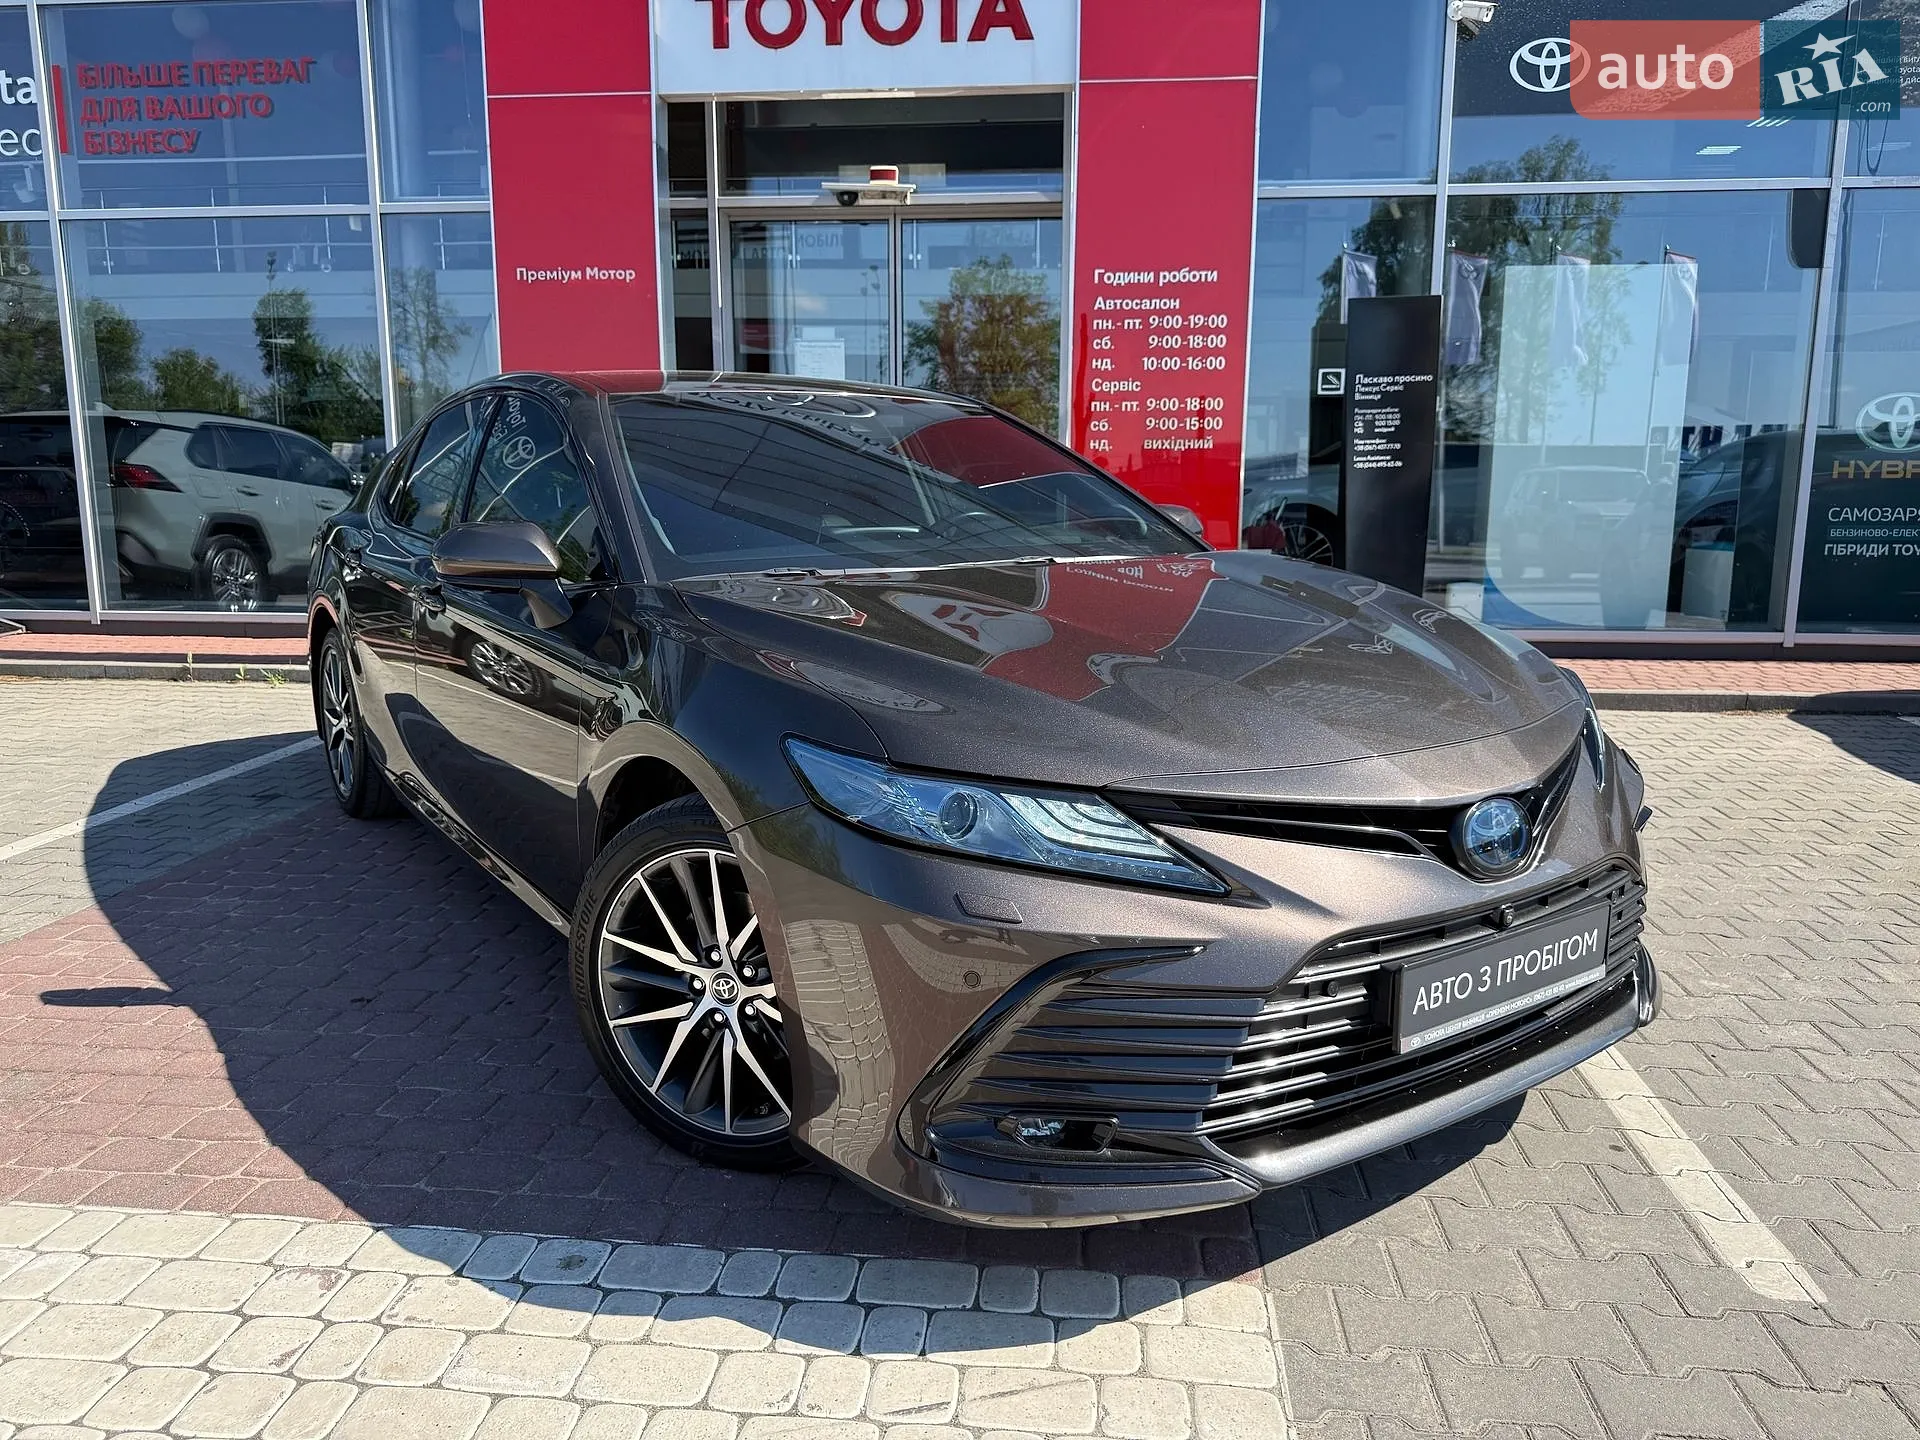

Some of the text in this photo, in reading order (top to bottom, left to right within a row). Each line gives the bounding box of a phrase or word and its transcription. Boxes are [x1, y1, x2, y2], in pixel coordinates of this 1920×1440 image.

[695, 0, 1035, 49] TOYOTA
[76, 57, 316, 89] БІЛЬШЕ ПЕРЕВАГ
[80, 93, 273, 125] ДЛЯ ВАШОГО
[84, 129, 199, 155] БІЗНЕСУ
[516, 266, 636, 283] Преміум Мотор
[1093, 267, 1218, 286] Години роботи
[1093, 296, 1180, 310] Автосалон
[1149, 314, 1228, 329] 9:00-19:00
[1092, 334, 1227, 350] сб. 9:00-18:00
[1092, 356, 1226, 371] нд. 10:00-16:00
[1091, 378, 1142, 394] Сервіс
[1395, 374, 1433, 385] просимо
[1146, 397, 1224, 412] 9:00-18:00
[1090, 417, 1223, 432] сб. 9:00-15:00
[1090, 436, 1214, 451] нд. вихідний
[1824, 544, 1889, 557] ГІБРИДИ
[1412, 972, 1473, 1015] АВТО
[1497, 928, 1598, 986] ПРОБІГОМ
